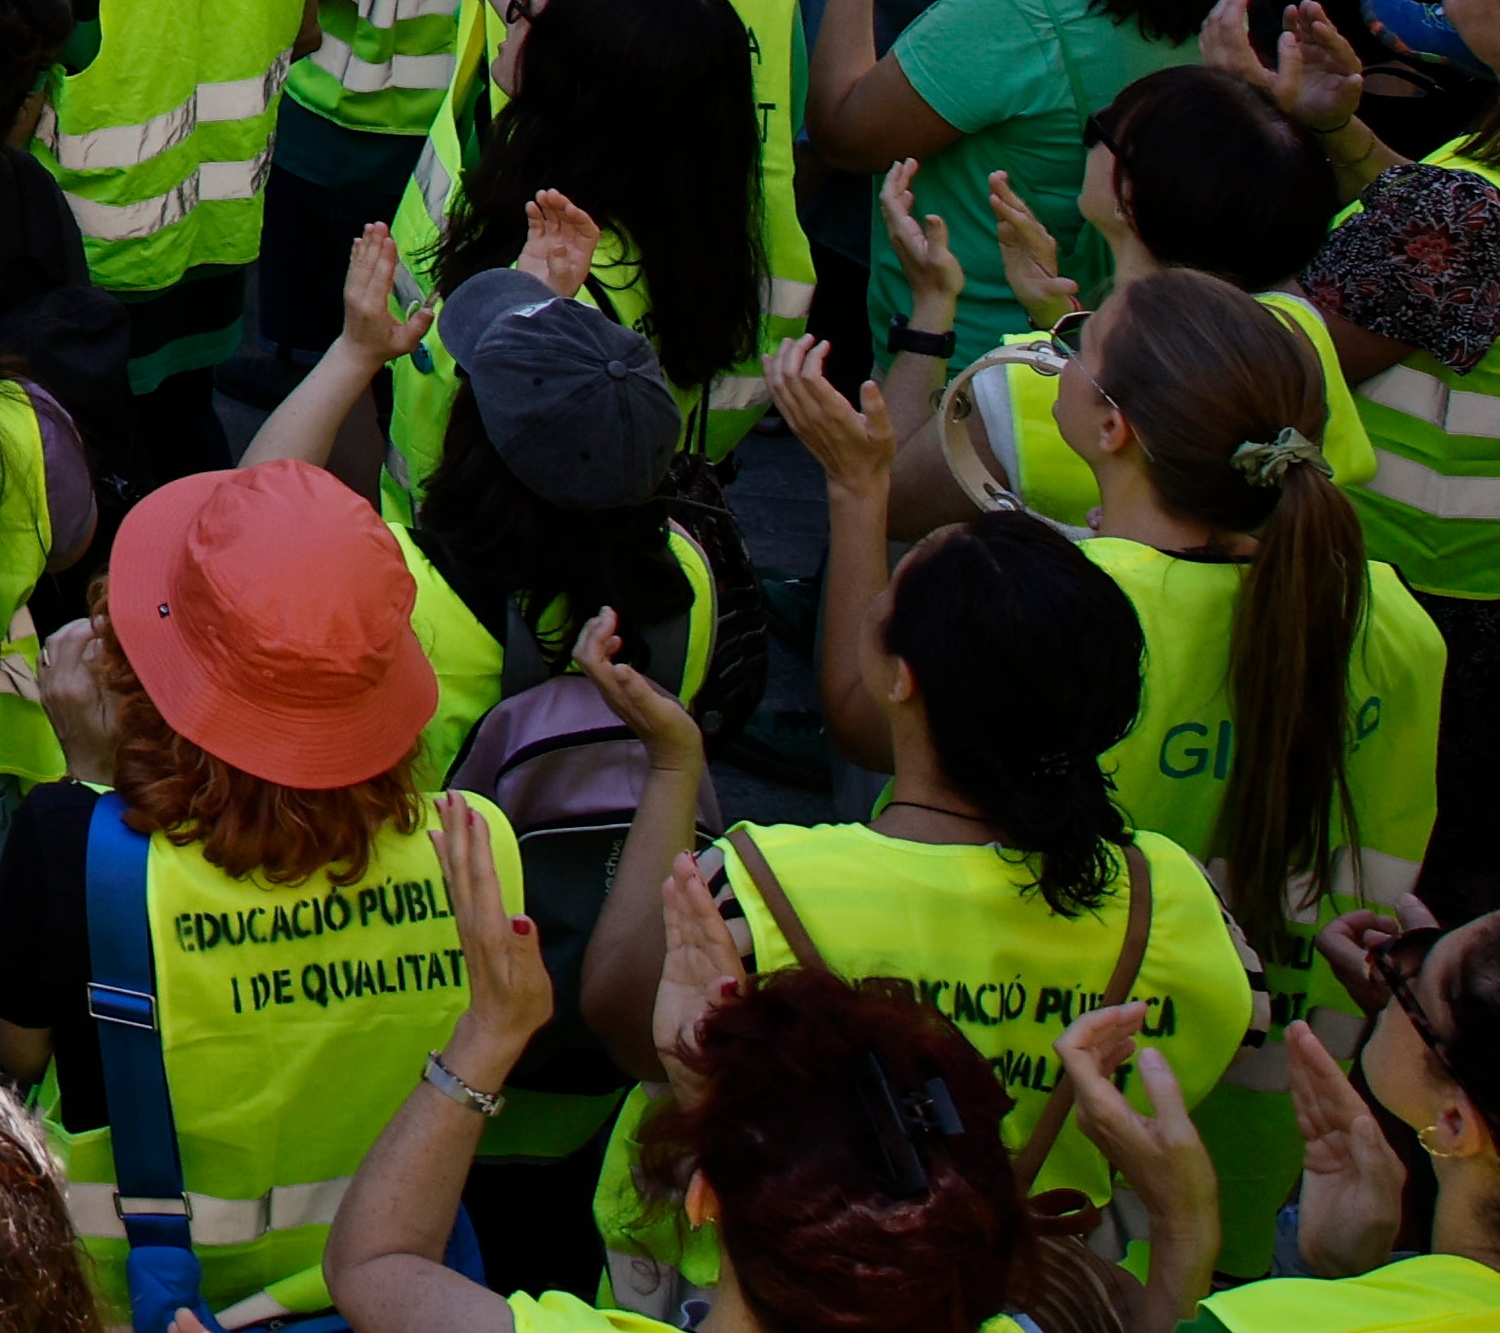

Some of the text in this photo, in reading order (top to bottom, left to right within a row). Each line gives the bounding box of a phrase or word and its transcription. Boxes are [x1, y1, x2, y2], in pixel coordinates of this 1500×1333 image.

[174, 885, 351, 953] EDUCACIÓ
[232, 975, 242, 1014] I
[248, 965, 295, 1011] DE
